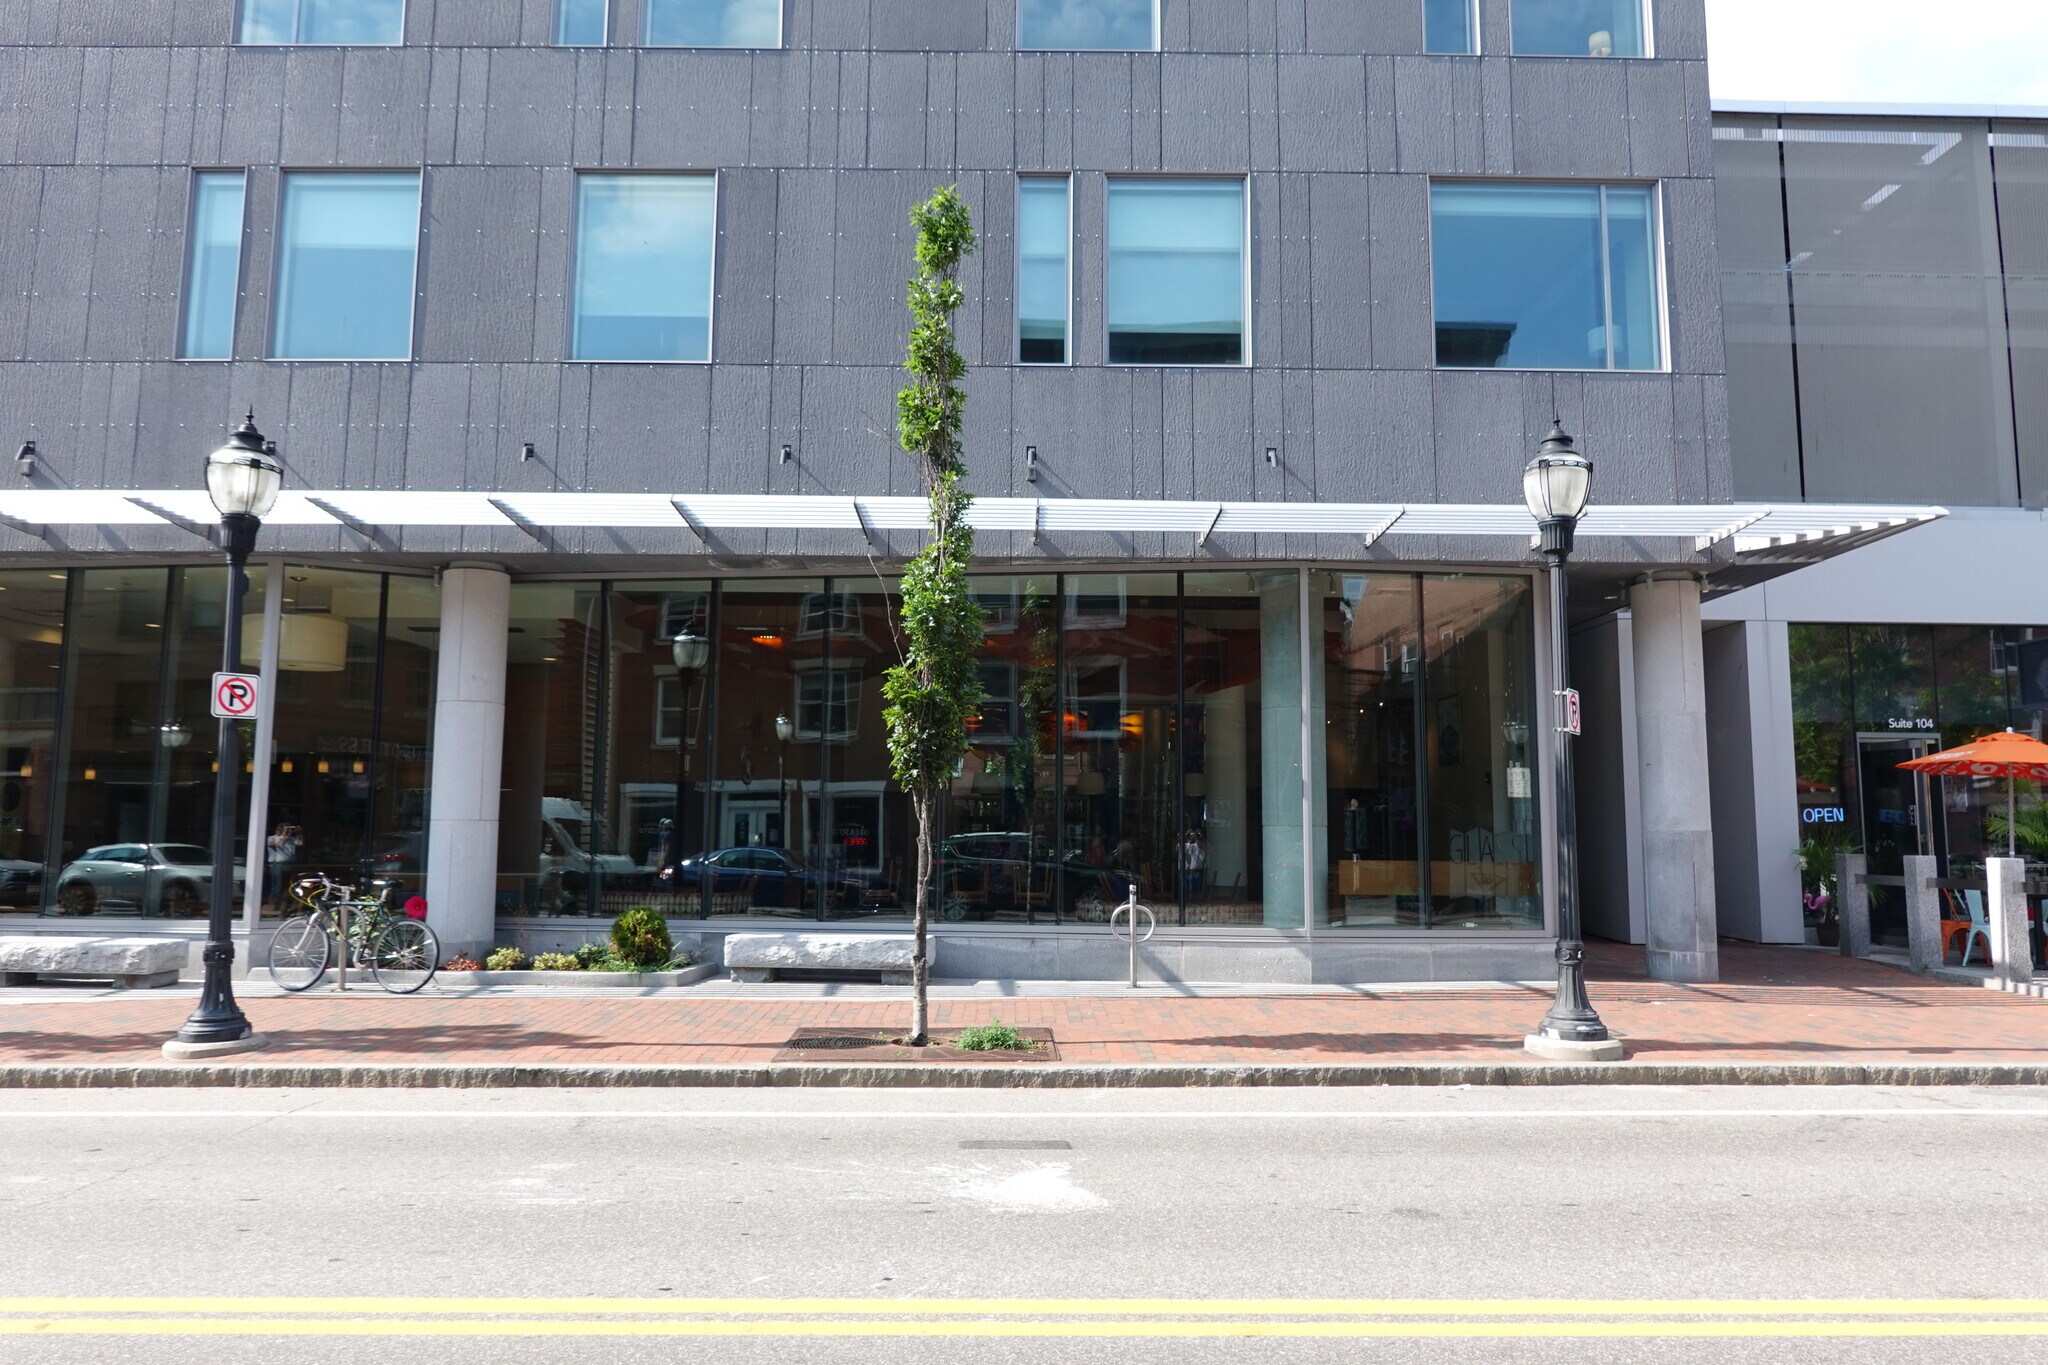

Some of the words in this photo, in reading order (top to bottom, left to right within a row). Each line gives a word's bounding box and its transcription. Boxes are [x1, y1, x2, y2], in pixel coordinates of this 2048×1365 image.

[1888, 717, 1913, 729] Suite
[1915, 718, 1934, 729] 104
[1803, 807, 1845, 823] OPEN
